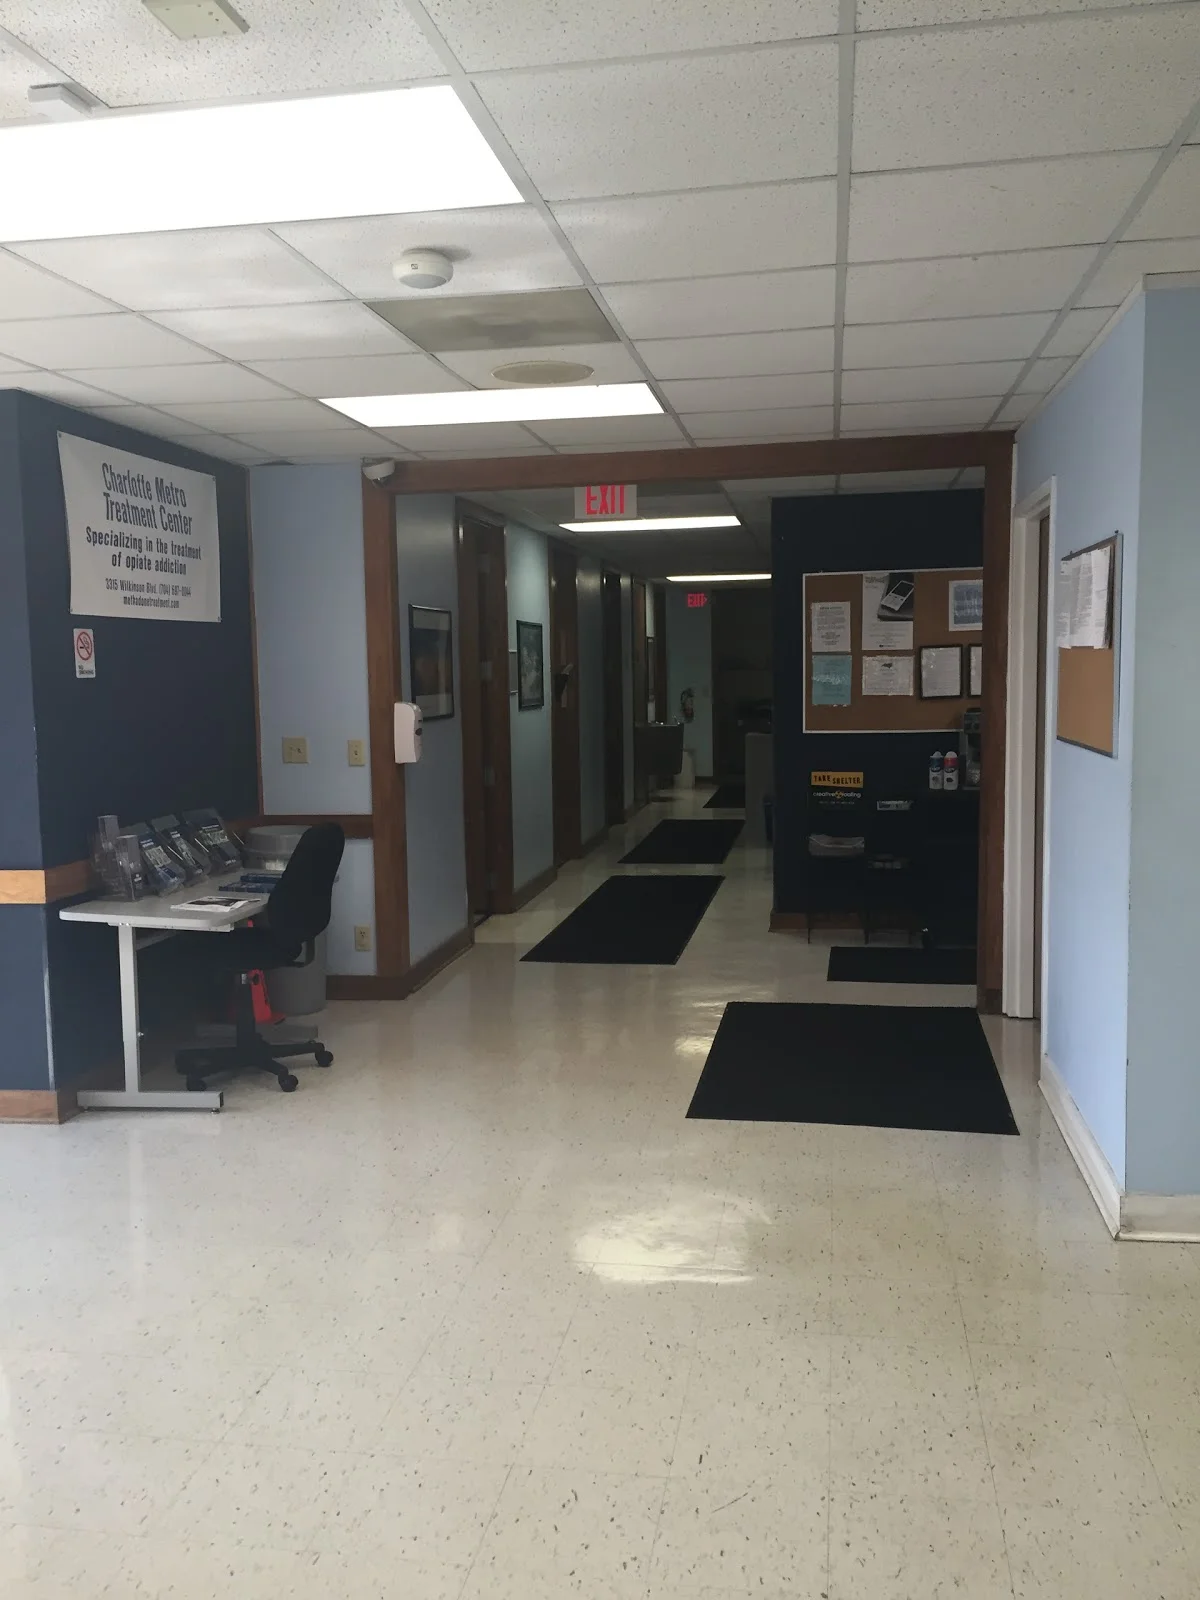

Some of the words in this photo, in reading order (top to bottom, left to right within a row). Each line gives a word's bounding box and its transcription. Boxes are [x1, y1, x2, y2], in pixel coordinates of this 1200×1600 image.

[102, 463, 153, 501] Charlotte
[155, 477, 187, 508] Metro
[586, 484, 625, 515] EXIT
[103, 492, 158, 529] Treatment
[159, 505, 192, 536] Center
[86, 526, 143, 554] Specializing
[145, 536, 153, 553] in
[156, 538, 168, 555] the
[171, 541, 202, 560] treatment
[111, 552, 122, 567] of
[125, 554, 152, 571] opiate
[154, 557, 187, 575] addiction
[105, 578, 119, 591] 3315
[119, 580, 145, 593] Wilkinson
[814, 775, 831, 783] TAKE
[832, 777, 861, 785] SHELTER
